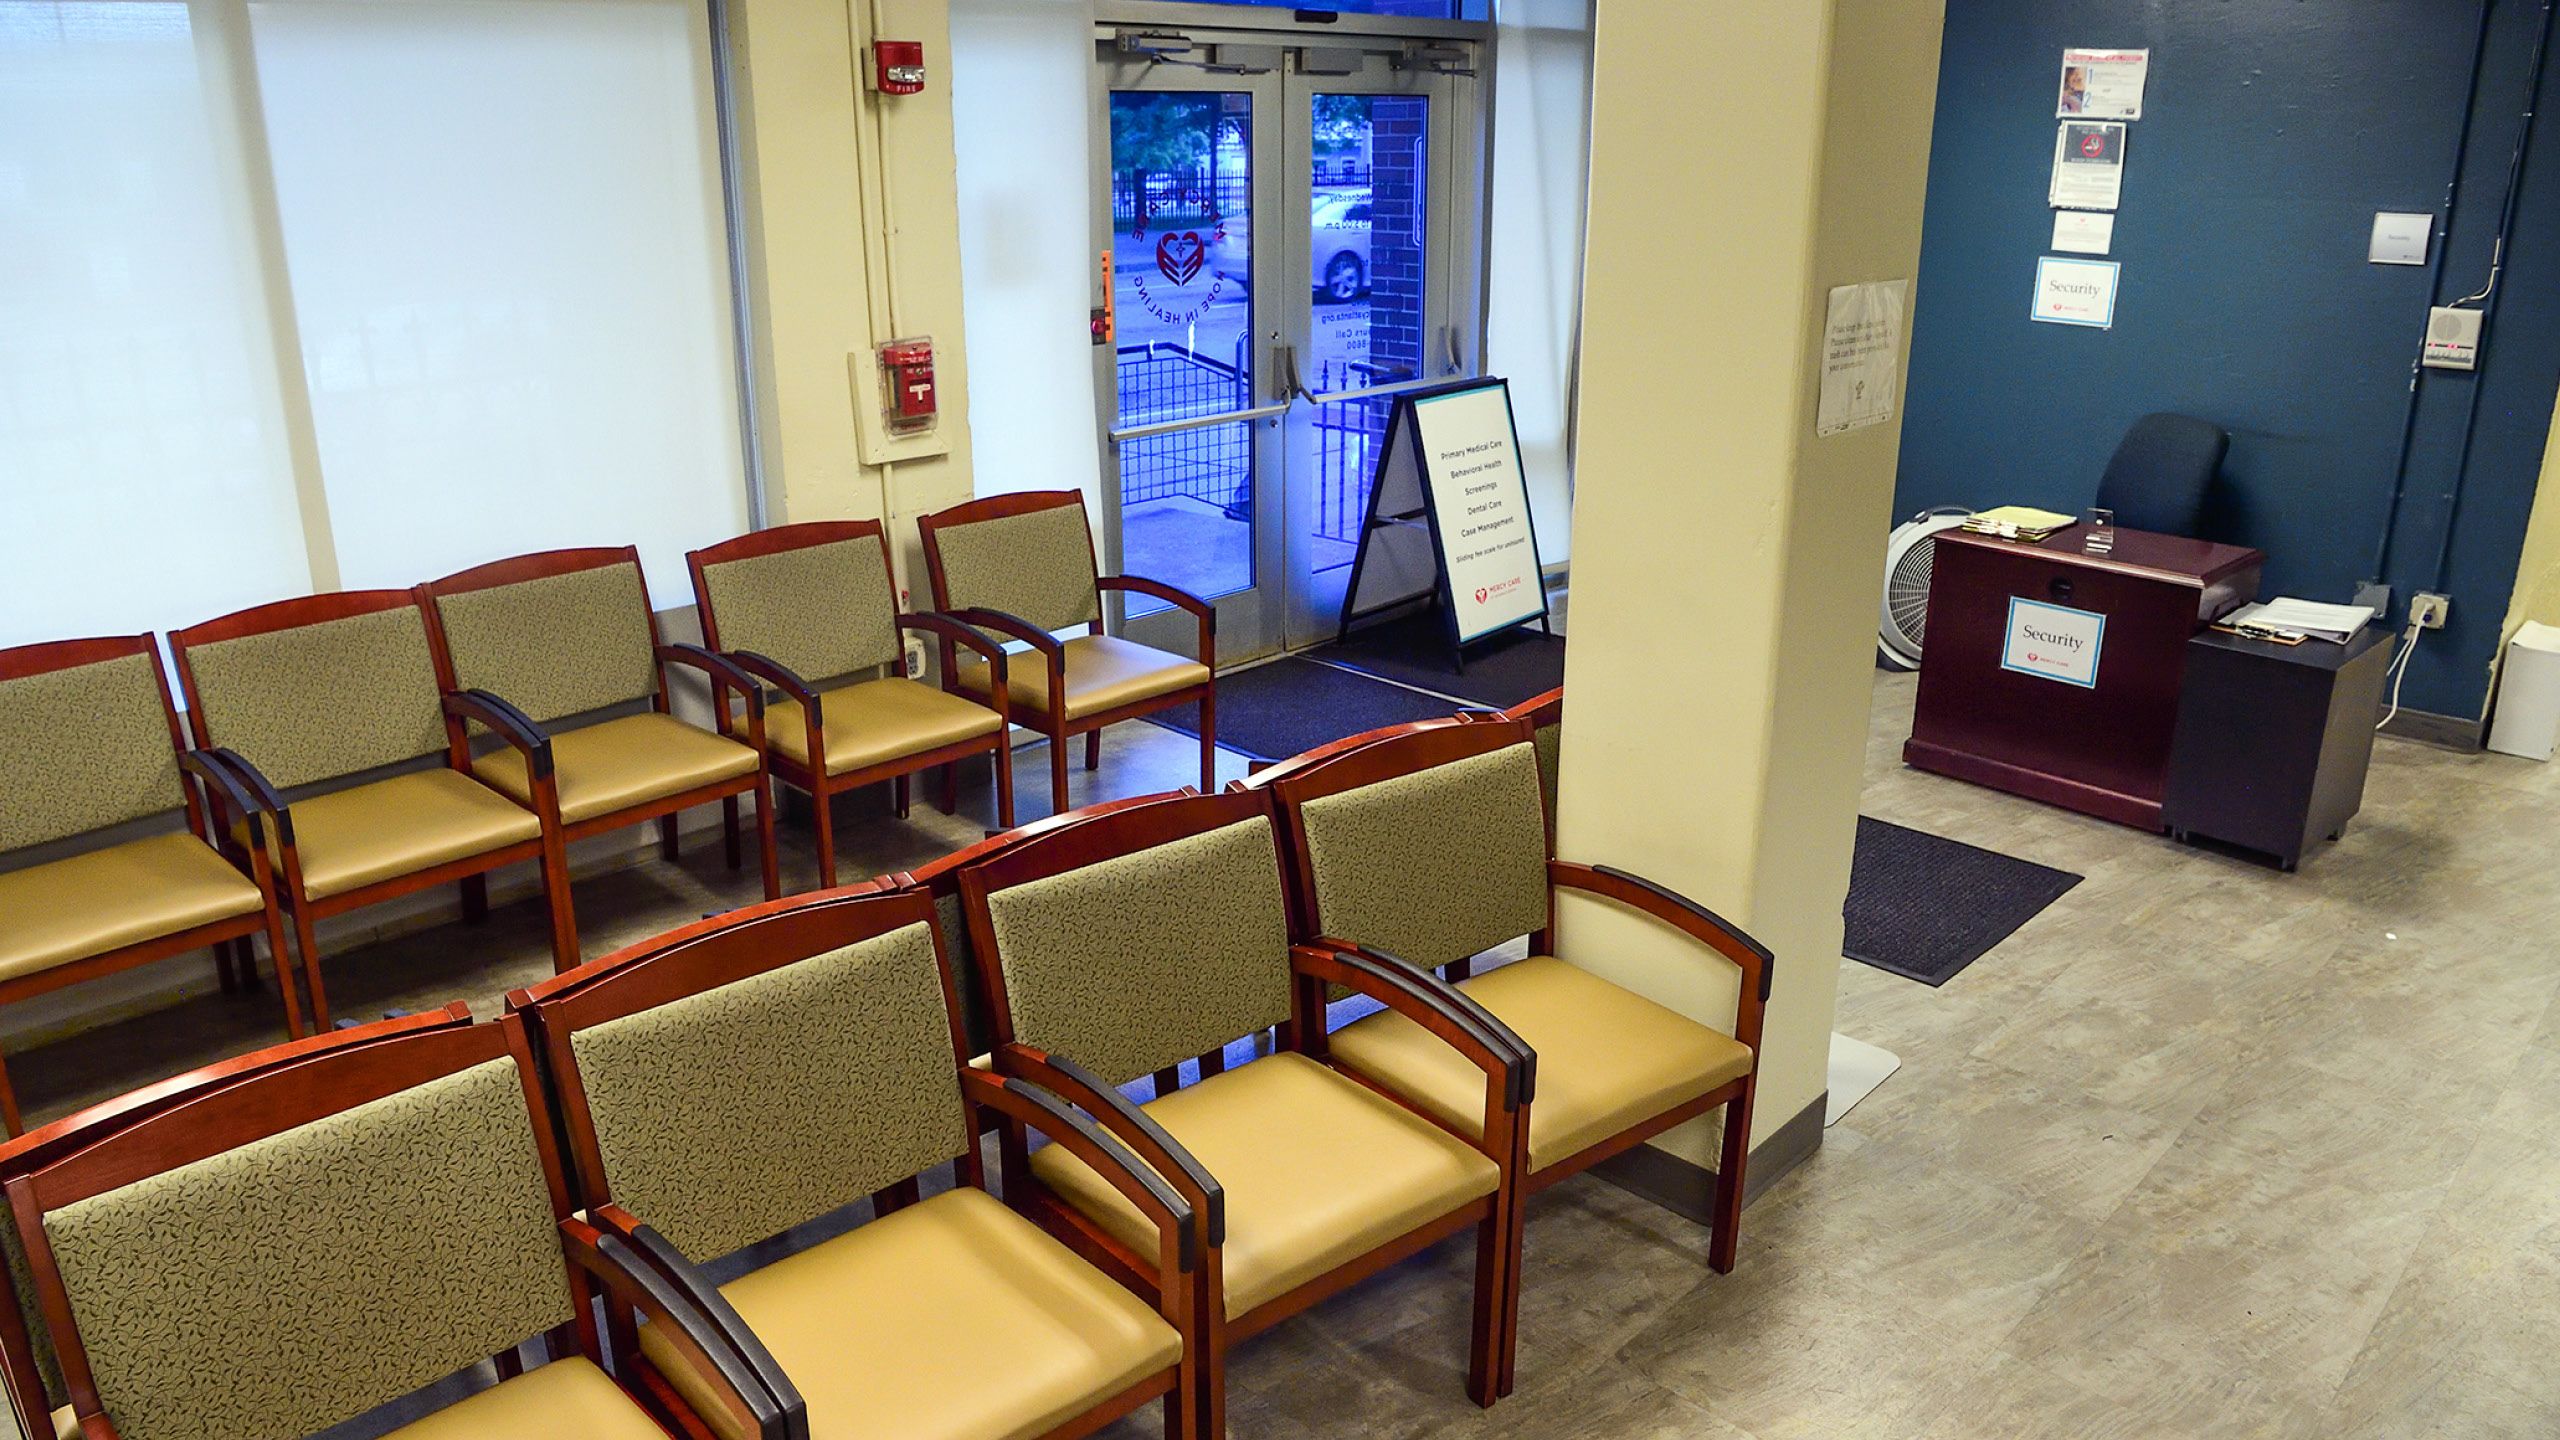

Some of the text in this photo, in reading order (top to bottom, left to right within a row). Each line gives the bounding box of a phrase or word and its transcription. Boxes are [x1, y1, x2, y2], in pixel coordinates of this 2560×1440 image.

[2083, 91, 2092, 108] 2
[2049, 279, 2102, 299] Security
[1440, 440, 1502, 460] Primary Medical Care
[1450, 460, 1502, 479] Behavioral Health
[1464, 482, 1498, 496] Screenings
[1467, 500, 1502, 515] Dental Care
[1461, 516, 1514, 537] Case Management
[1456, 552, 1474, 563] Sliding
[1484, 546, 1496, 555] scale
[1489, 577, 1521, 592] MERCY CARE
[2023, 624, 2084, 653] Security
